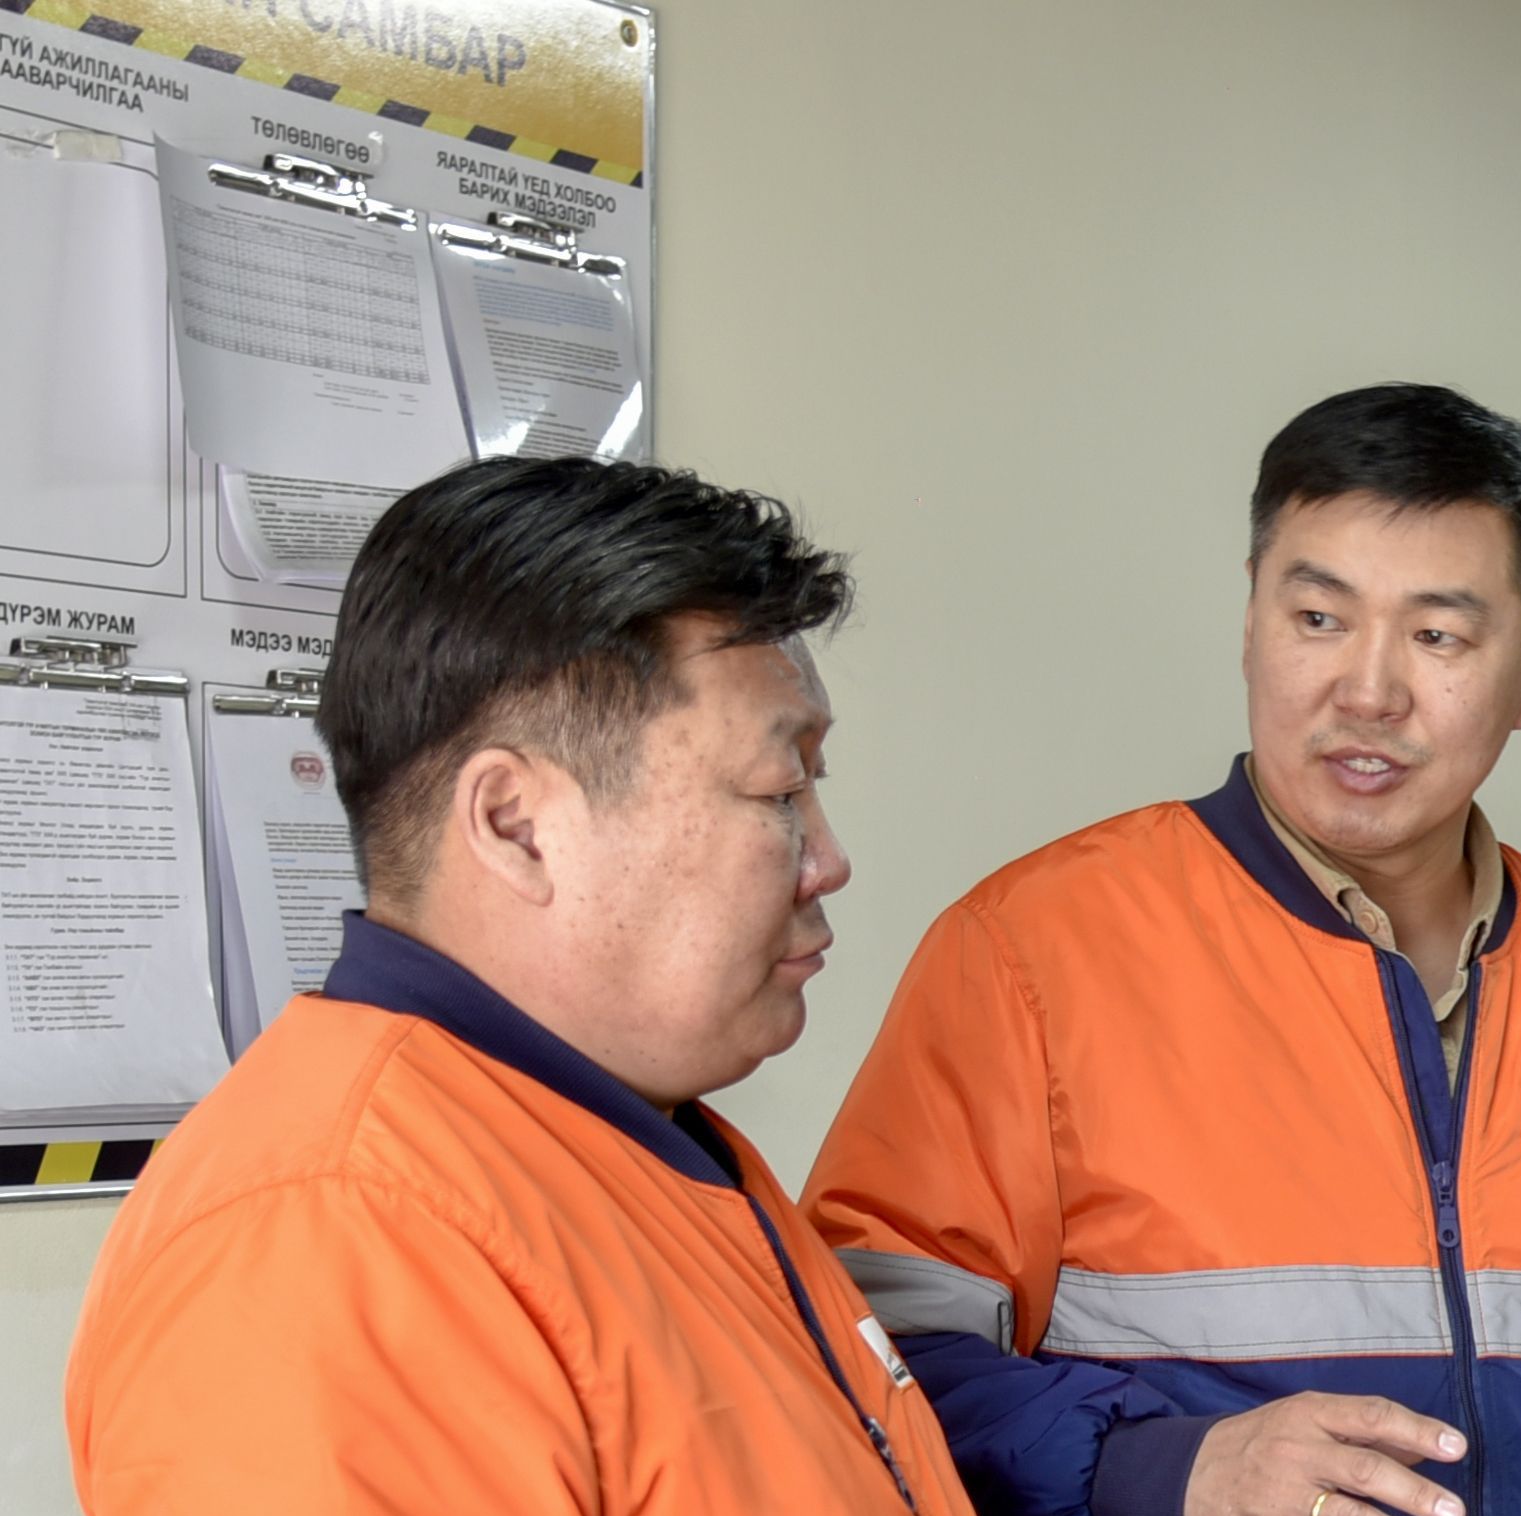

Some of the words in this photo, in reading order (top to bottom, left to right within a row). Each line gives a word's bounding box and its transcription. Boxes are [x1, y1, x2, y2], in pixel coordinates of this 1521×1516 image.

[300, 0, 527, 86] САМБАР
[39, 45, 189, 102] АЖИЛЛАГААНЫ
[251, 115, 370, 164] ТӨЛӨВЛӨГӨӨ
[436, 150, 519, 188] ЯАРАЛТАЙ
[521, 173, 551, 197] ҮЕД
[553, 182, 617, 213] ХОЛБОО
[458, 177, 511, 206] БАРИХ
[514, 193, 597, 229] МЭДЭЭЛЭЛ
[67, 610, 135, 635] ЖУРАМ
[231, 628, 293, 652] МЭДЭЭ
